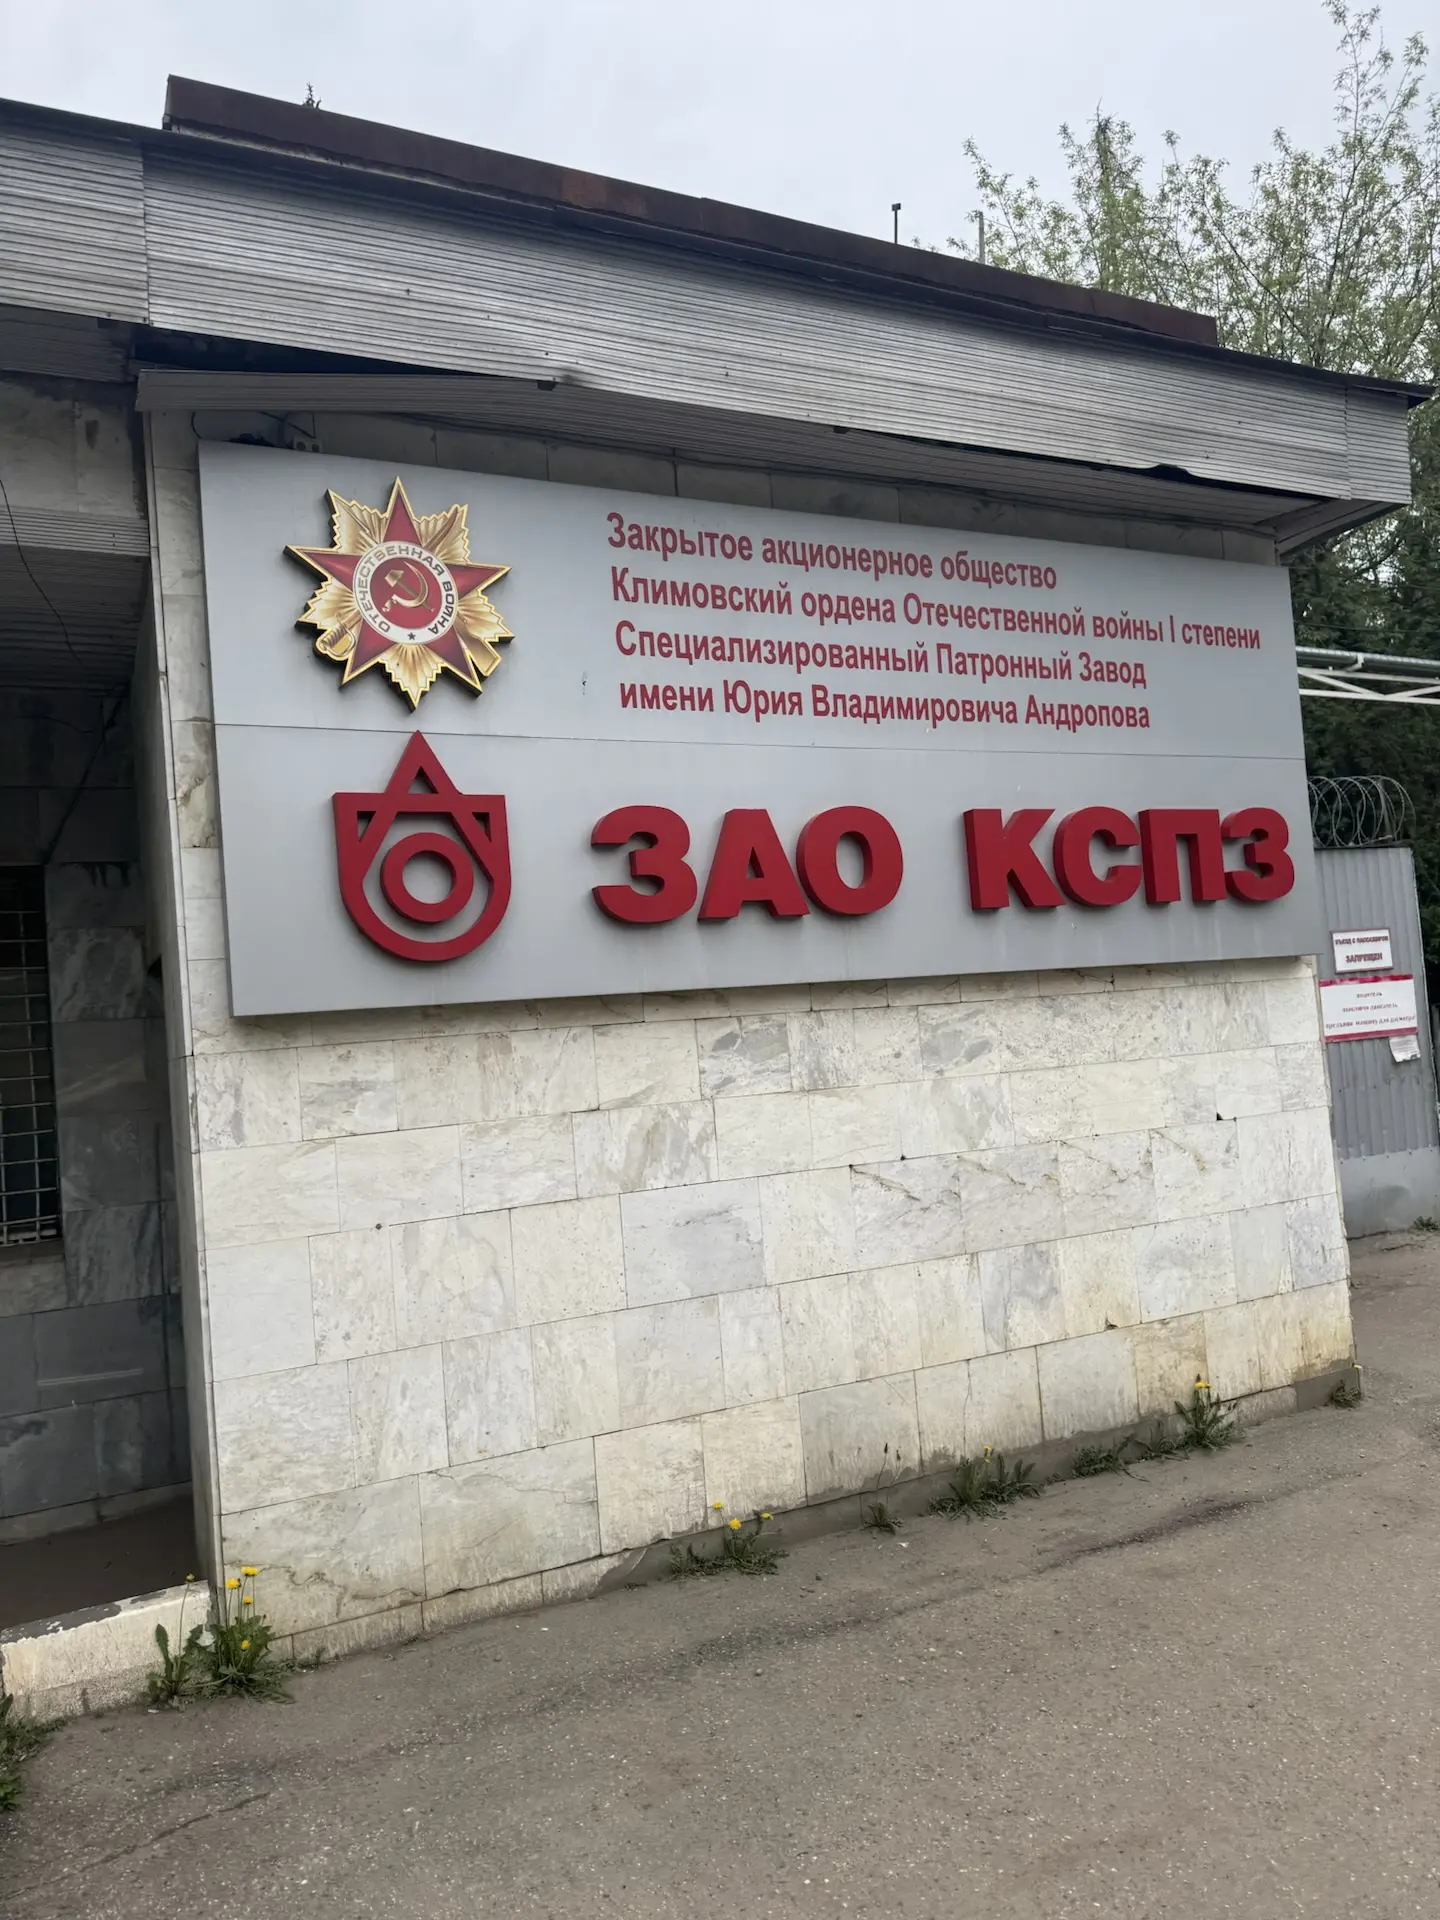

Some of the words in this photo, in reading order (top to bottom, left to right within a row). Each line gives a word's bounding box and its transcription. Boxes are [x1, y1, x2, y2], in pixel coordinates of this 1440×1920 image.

[357, 545, 445, 633] ОТЕЧЕСТВЕННАЯ
[607, 511, 753, 561] Закрытое
[762, 538, 932, 580] акционерное
[941, 551, 1057, 588] общество
[611, 566, 793, 614] Климовский
[801, 591, 896, 625] ордена
[903, 592, 1086, 637] Отечественной
[1093, 611, 1162, 641] войны
[1181, 623, 1261, 648] степени
[615, 619, 929, 675] Специализированный
[936, 641, 1073, 684] Патронный
[1079, 651, 1147, 688] Завод
[619, 682, 715, 713] имени
[723, 679, 804, 723] Юрия
[810, 683, 1019, 729] Владимировича
[1024, 695, 1151, 733] Андропова
[592, 804, 904, 923] ЗАО
[963, 806, 1295, 910] КСПЗ
